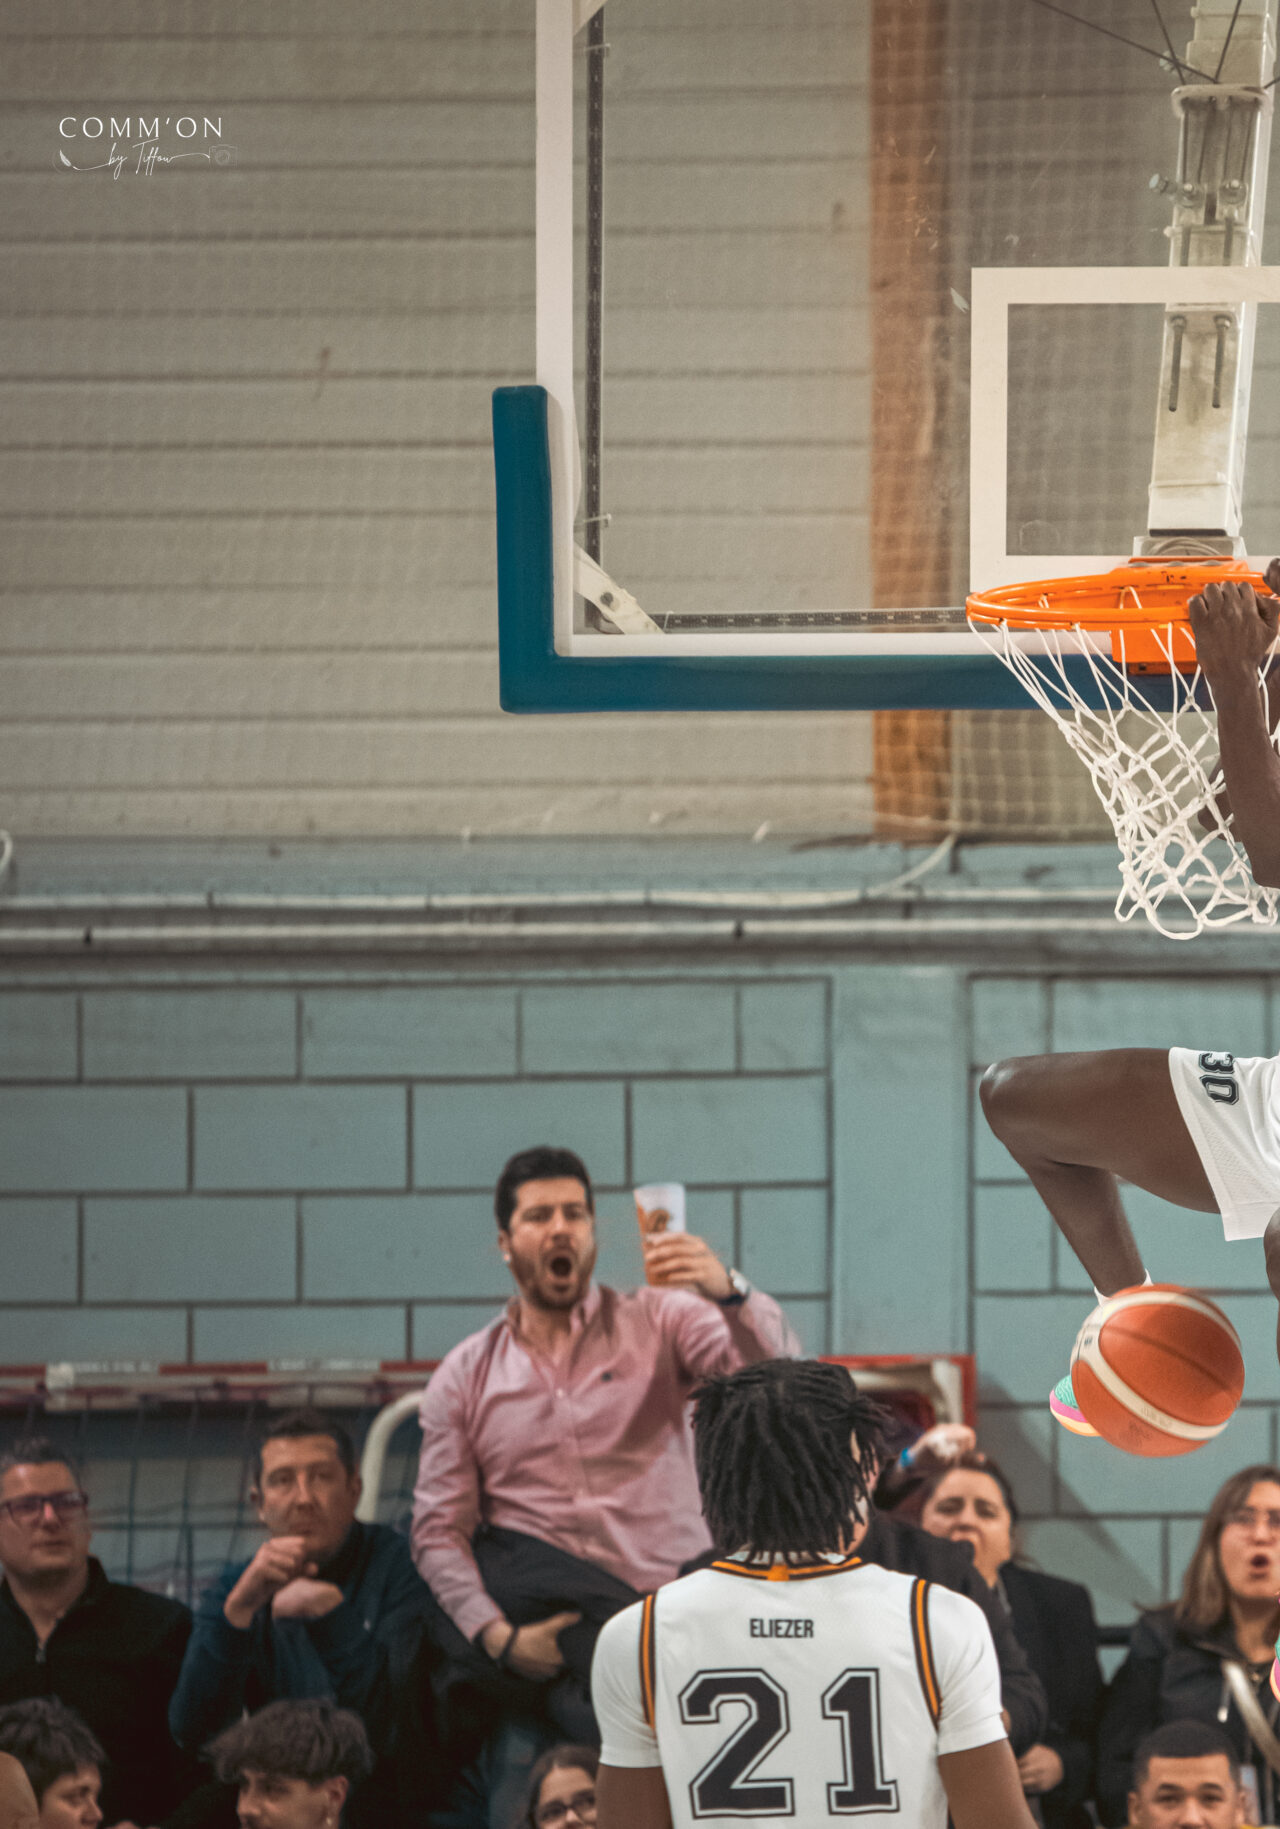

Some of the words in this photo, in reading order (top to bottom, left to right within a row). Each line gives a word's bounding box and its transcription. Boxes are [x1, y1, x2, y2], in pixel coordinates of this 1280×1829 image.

[1199, 1052, 1240, 1105] 30
[750, 1618, 814, 1639] ELIEZER
[678, 1668, 901, 1819] 21
